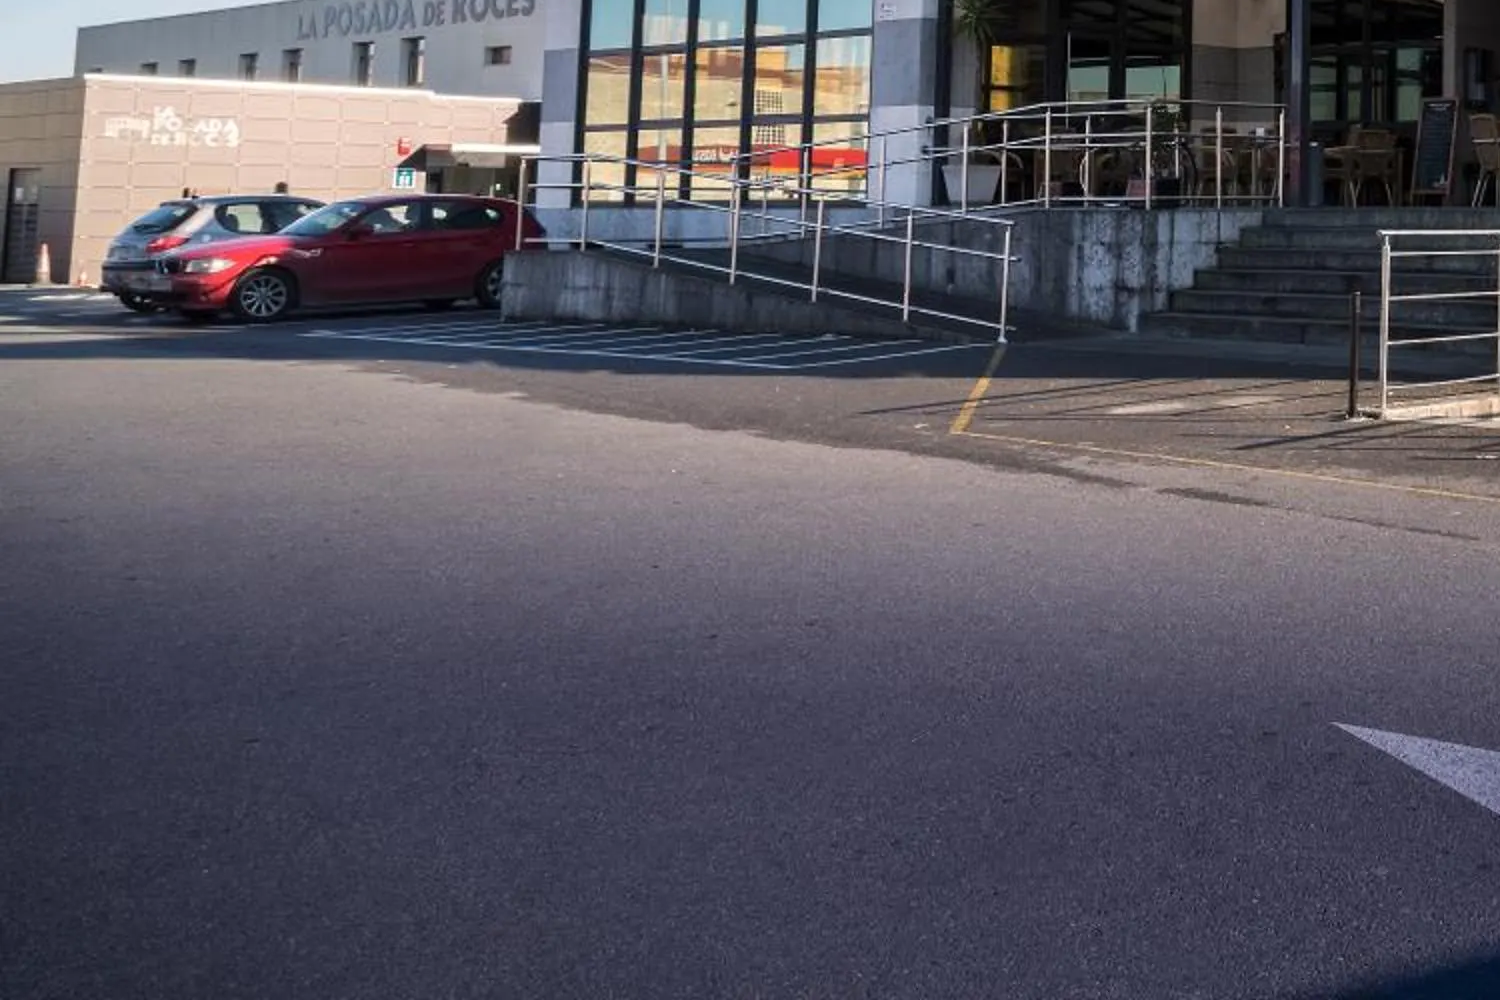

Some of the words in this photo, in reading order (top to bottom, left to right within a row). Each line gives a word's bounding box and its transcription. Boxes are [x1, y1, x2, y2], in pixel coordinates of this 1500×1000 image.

[298, 11, 317, 41] LA
[422, 0, 446, 27] DE
[152, 116, 238, 133] POADA
[174, 129, 239, 148] ROCS
